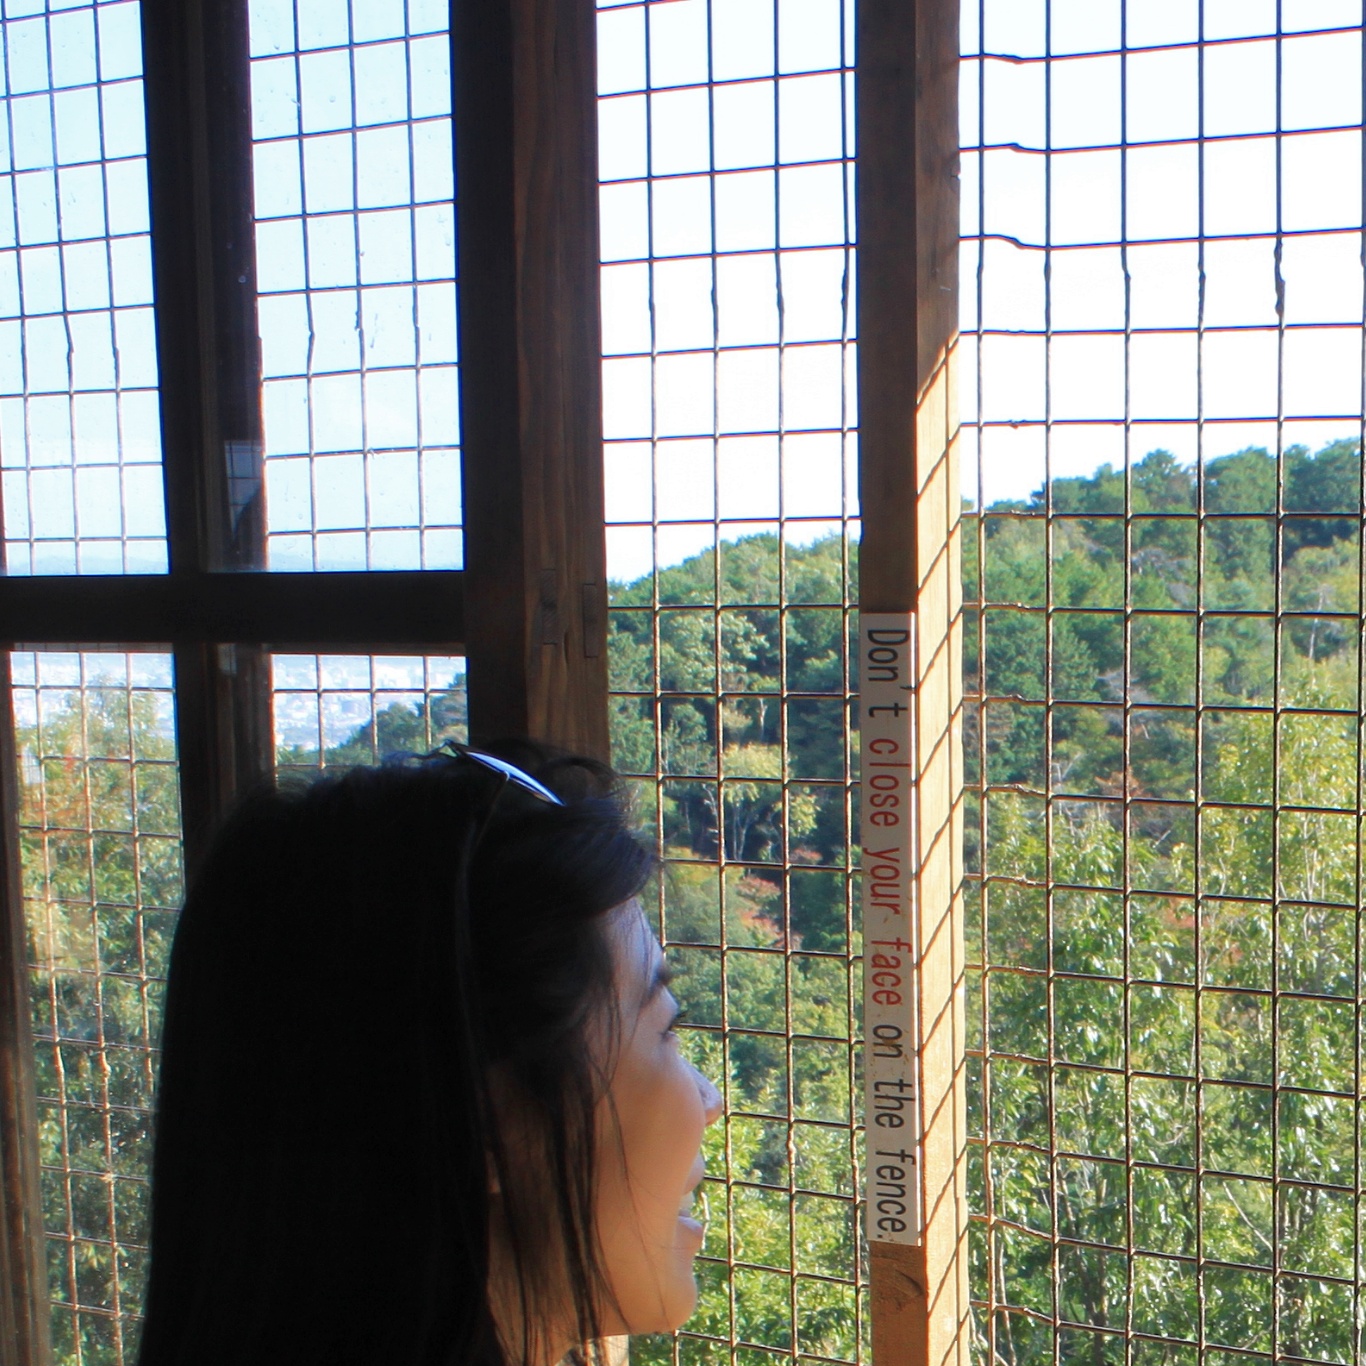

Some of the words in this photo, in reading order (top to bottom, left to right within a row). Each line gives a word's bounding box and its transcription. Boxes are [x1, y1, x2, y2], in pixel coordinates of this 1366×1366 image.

[868, 737, 912, 827] close
[862, 847, 901, 916] your
[870, 936, 912, 1006] face
[872, 1024, 904, 1058] on
[874, 1078, 915, 1130] the
[875, 1149, 917, 1240] fence.
